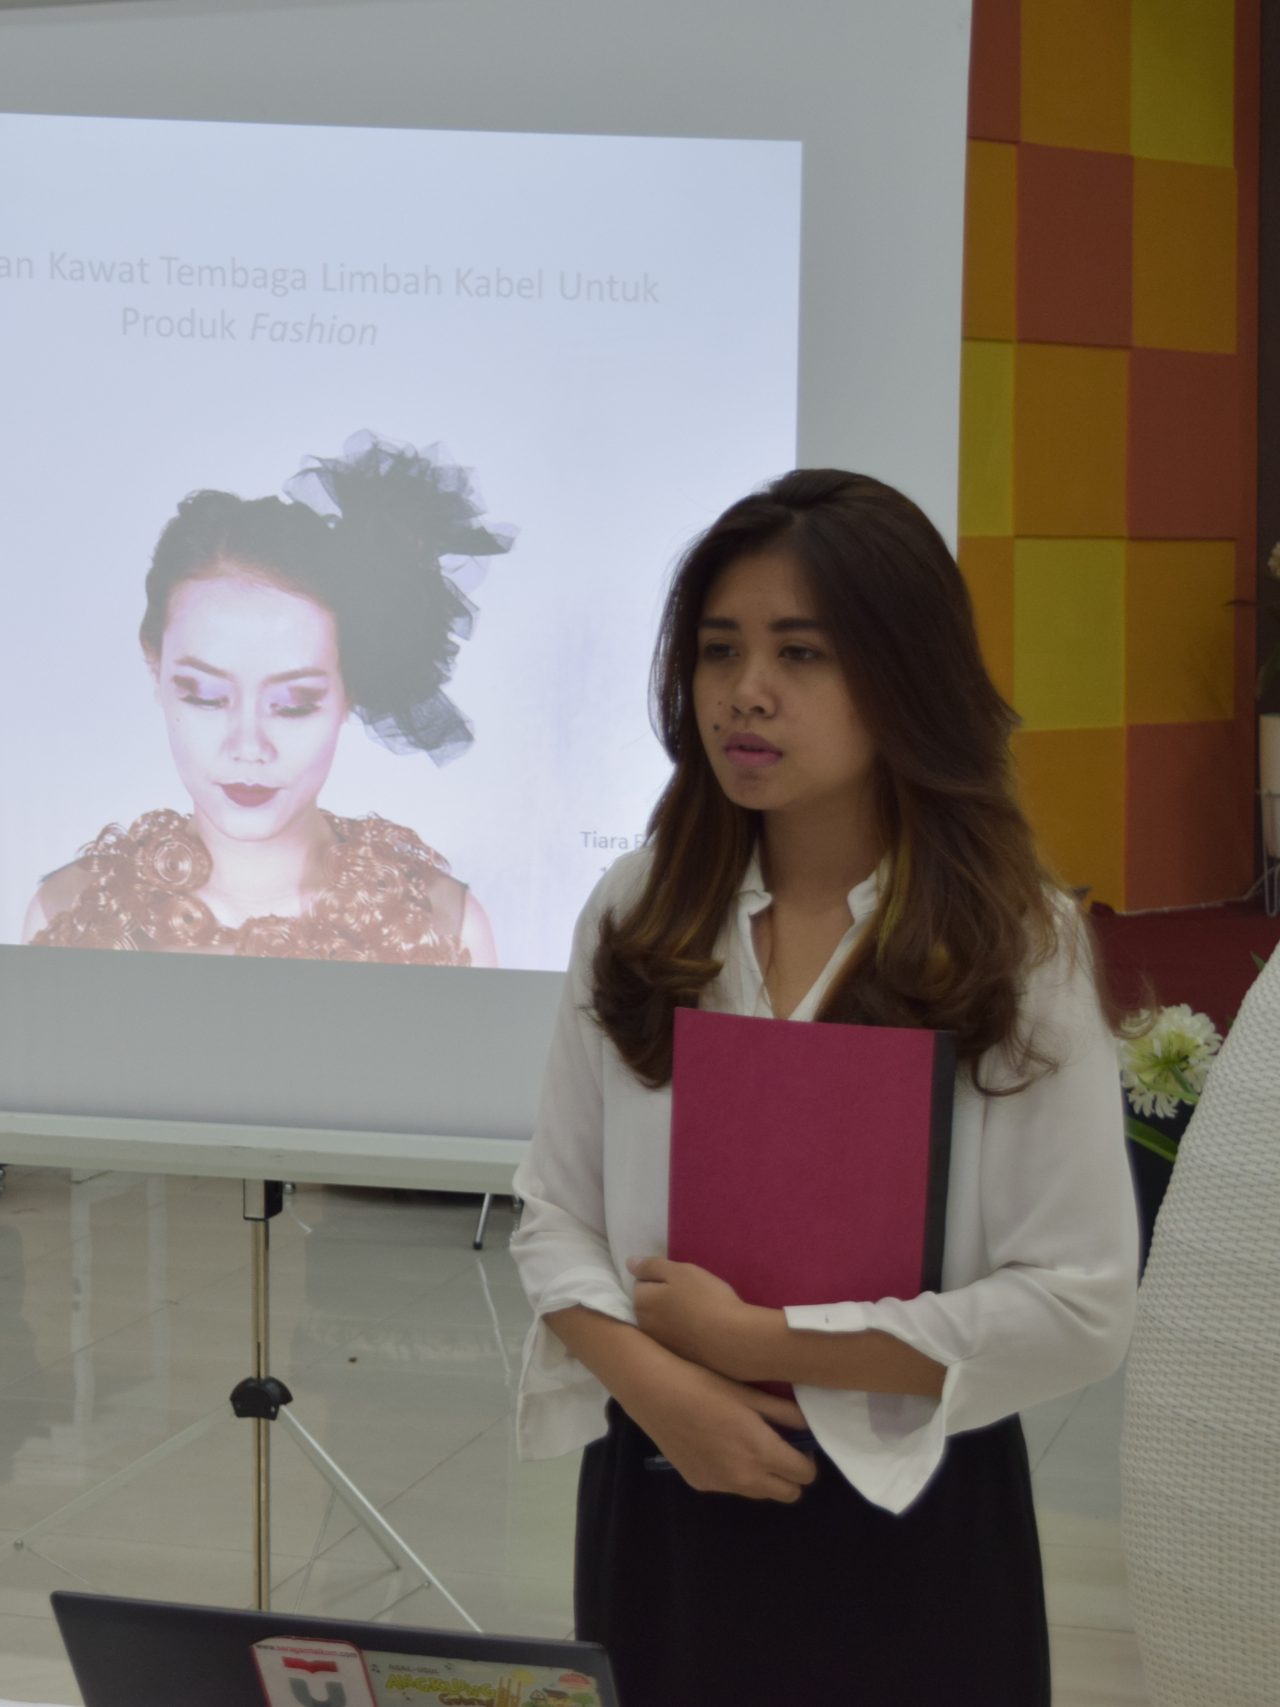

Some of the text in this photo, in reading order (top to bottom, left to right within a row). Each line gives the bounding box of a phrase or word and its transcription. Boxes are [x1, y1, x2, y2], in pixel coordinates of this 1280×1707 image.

[49, 251, 150, 285] Kawat
[159, 255, 307, 299] Tembaga
[322, 262, 443, 296] Limbah
[455, 267, 543, 300] Kabel
[559, 271, 660, 303] Untuk
[121, 306, 378, 346] Produk Fashion
[580, 831, 629, 849] Tiara
